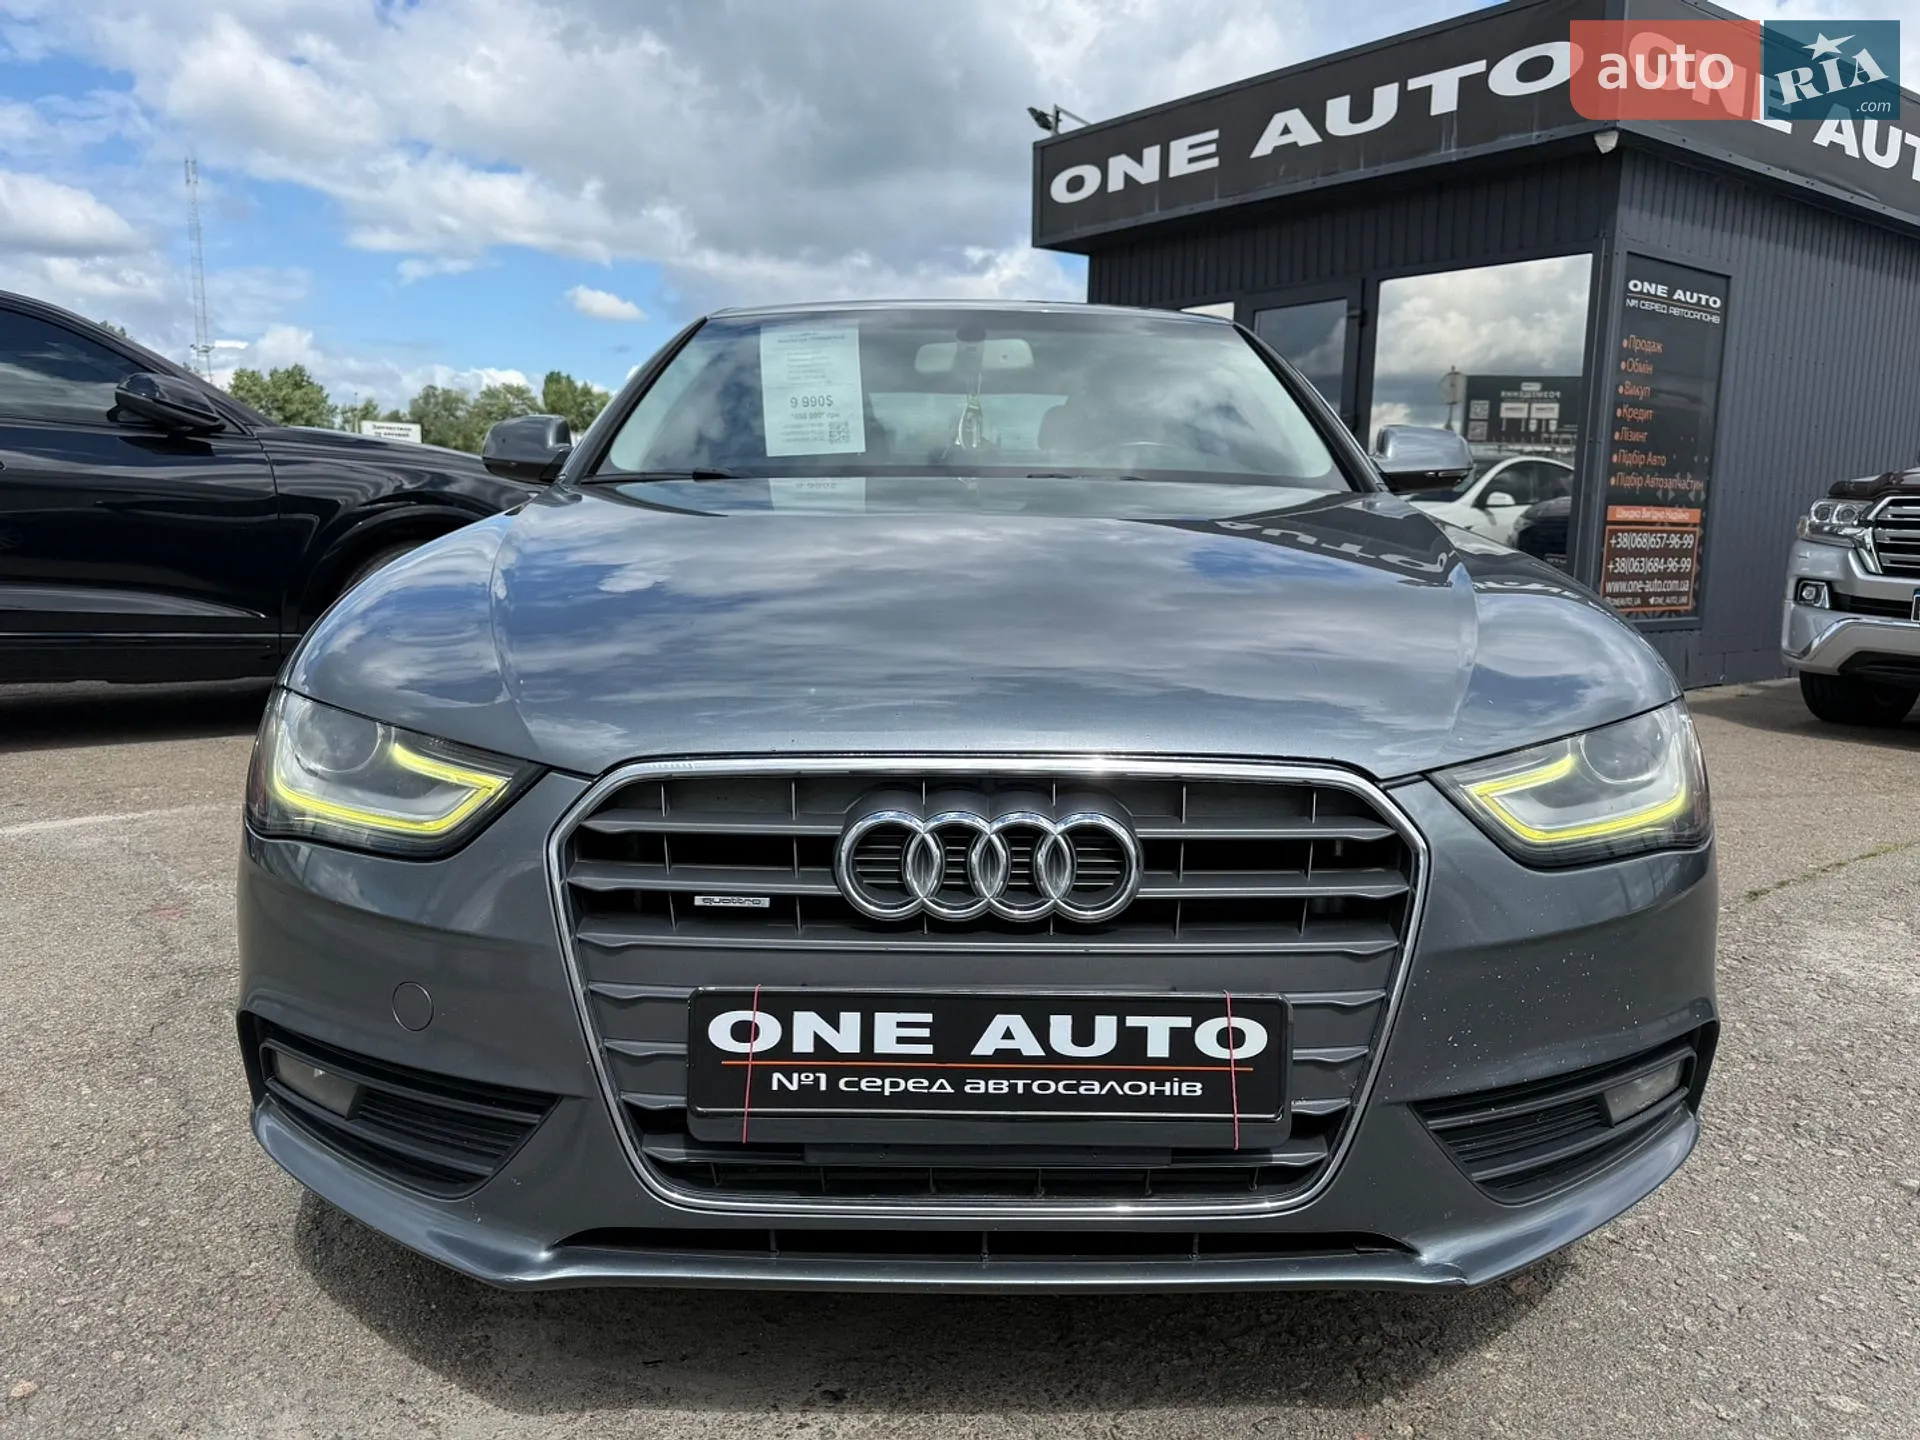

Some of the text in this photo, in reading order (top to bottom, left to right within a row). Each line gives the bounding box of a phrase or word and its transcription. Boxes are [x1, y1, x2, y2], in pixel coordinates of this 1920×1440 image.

[1050, 41, 1584, 203] ONE AUTO
[1628, 280, 1721, 308] ONE AUTO
[1629, 334, 1663, 354] Продаж
[1627, 358, 1653, 374] Обмін
[1624, 381, 1650, 400] Викуп
[1622, 404, 1654, 422] Кредит
[1621, 427, 1648, 442] Лізинг
[1618, 449, 1666, 468] Підбір Авто
[1616, 472, 1643, 493] Підбір
[1610, 532, 1694, 550] +38(068)657-96-99
[1608, 557, 1691, 575] +38(063)684-96-99
[1605, 578, 1689, 593] www.one-auto.com.ua
[702, 898, 761, 906] quattro
[708, 1010, 1268, 1060] ONE AUTO
[772, 1072, 1203, 1097] №1 серед автосалонів
